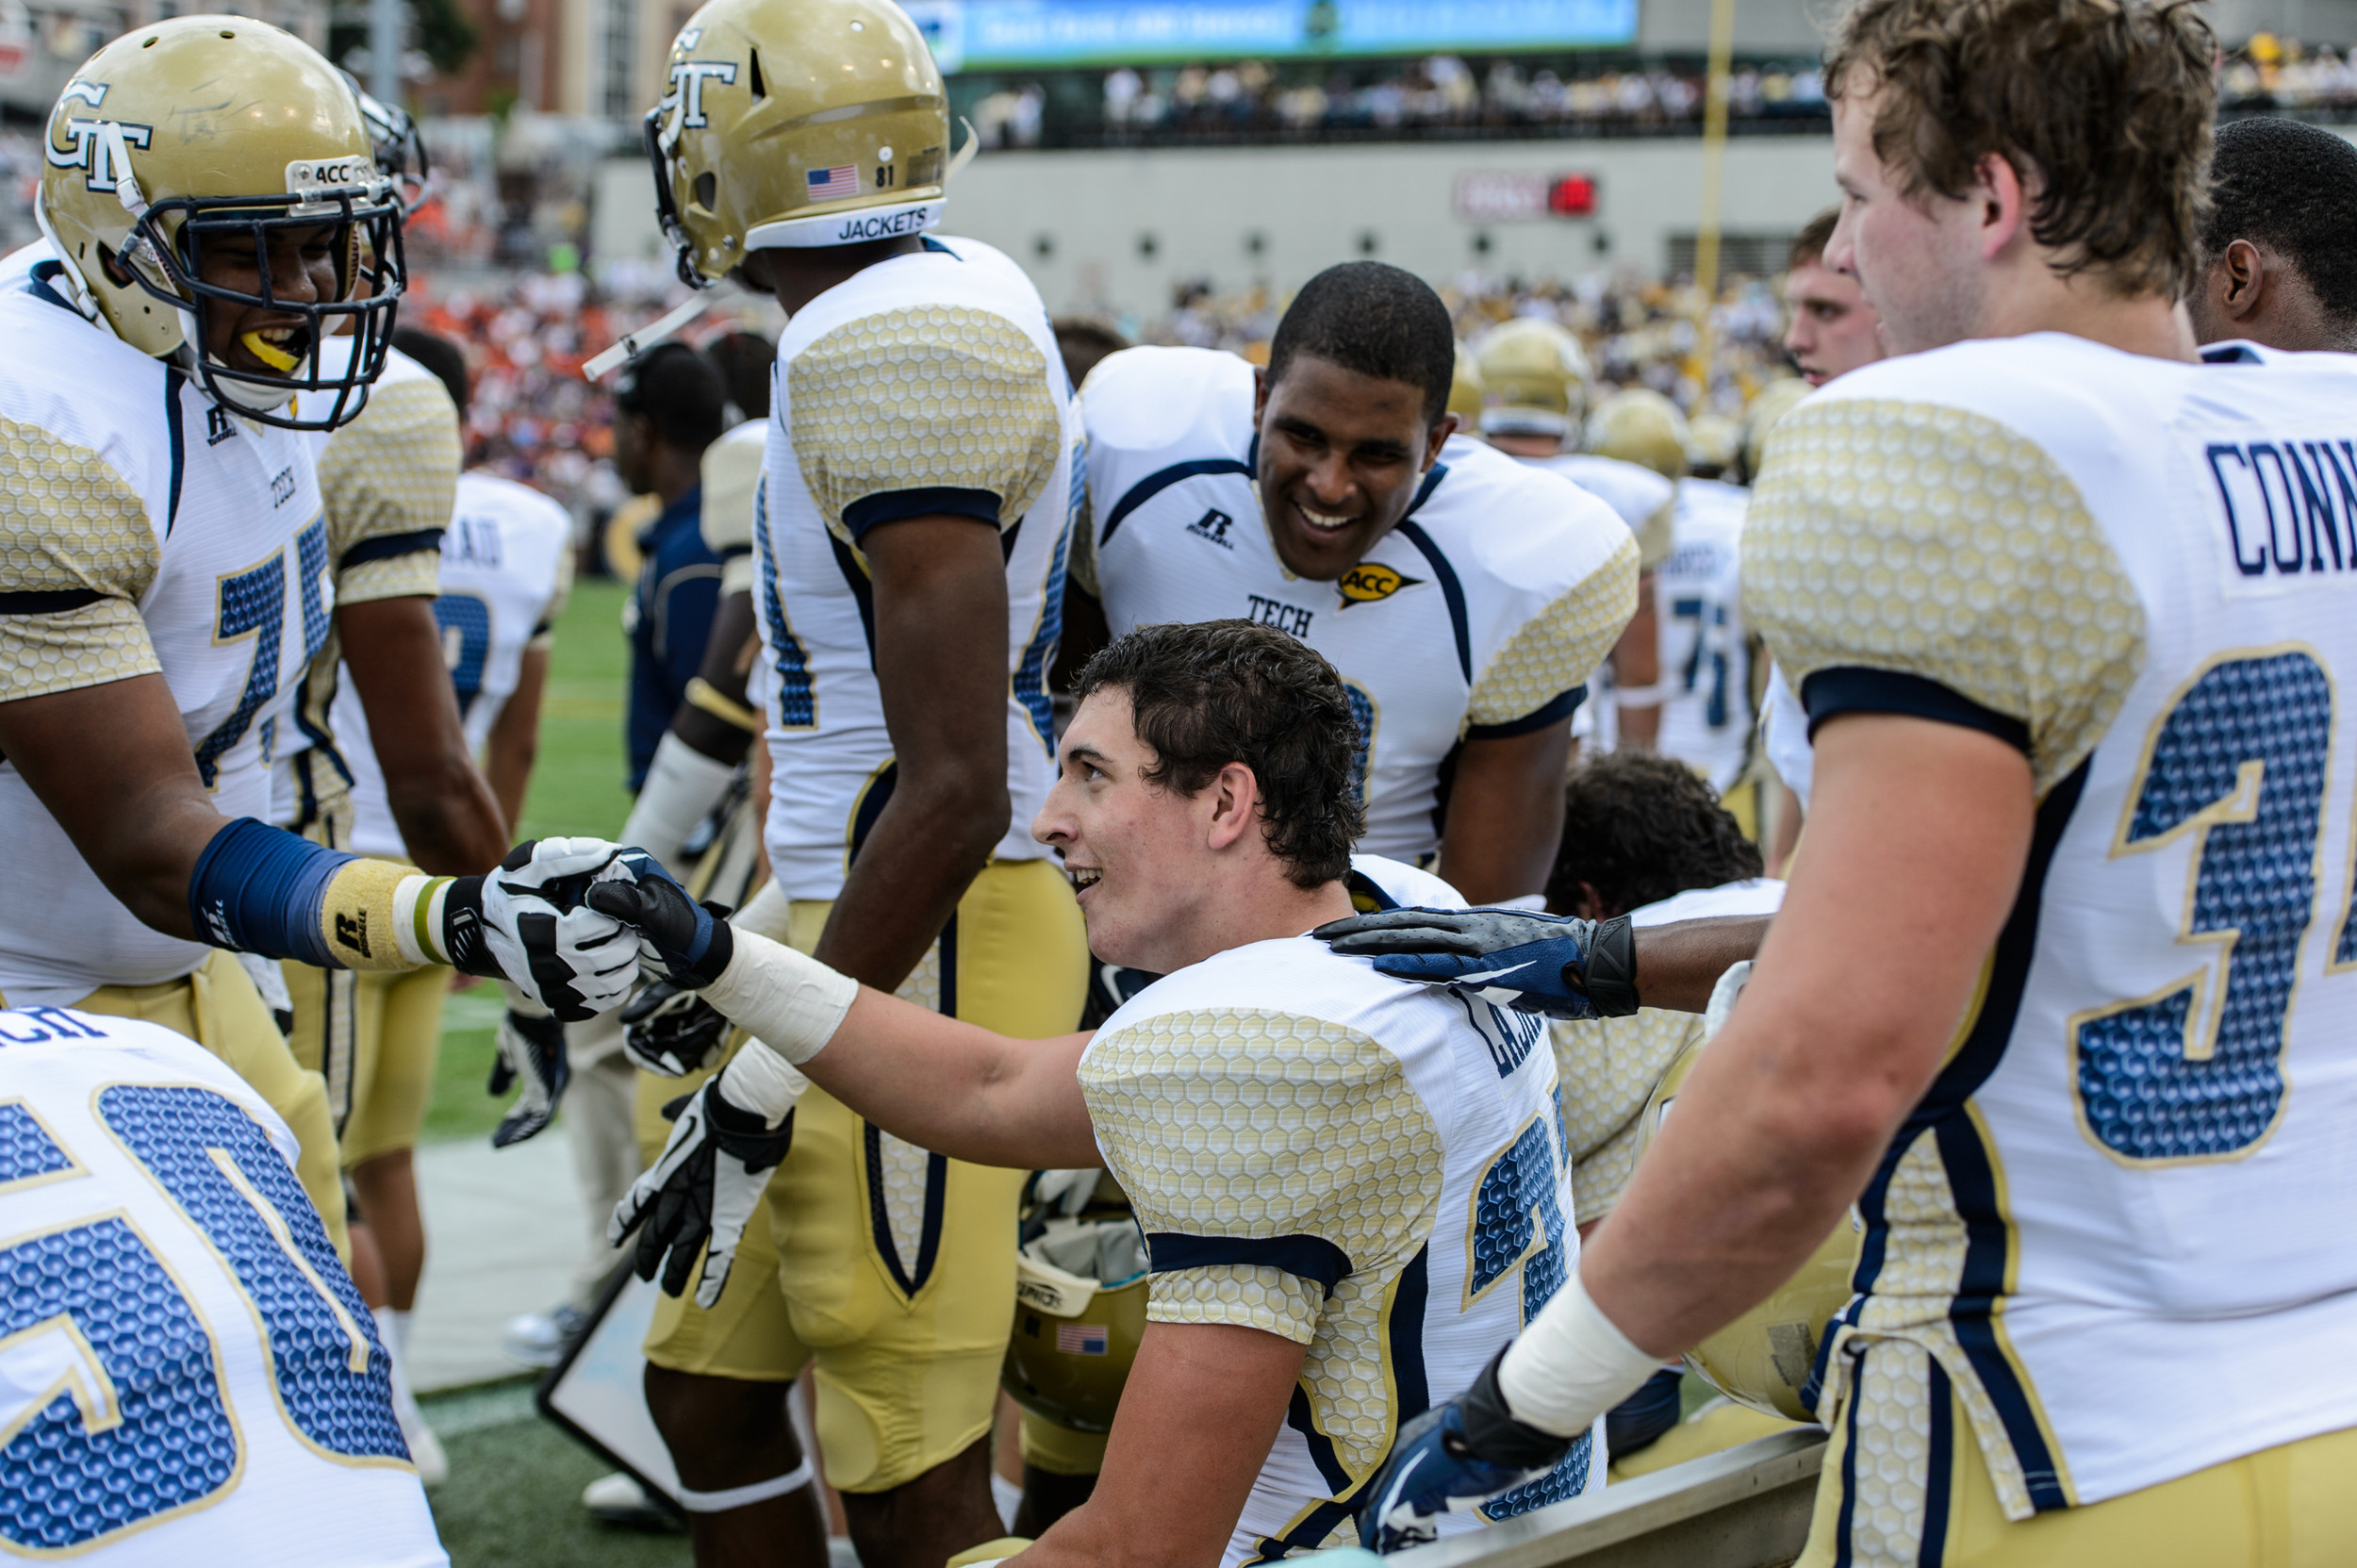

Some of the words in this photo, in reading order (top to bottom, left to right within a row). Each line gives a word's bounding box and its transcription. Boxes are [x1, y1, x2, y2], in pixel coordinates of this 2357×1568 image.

[44, 79, 154, 194] GT
[316, 164, 350, 184] ACC
[876, 164, 894, 188] 81
[839, 206, 928, 240] JACKETS
[1343, 570, 1393, 596] ACC
[1248, 594, 1314, 638] TECH
[2068, 641, 2357, 1169] 3
